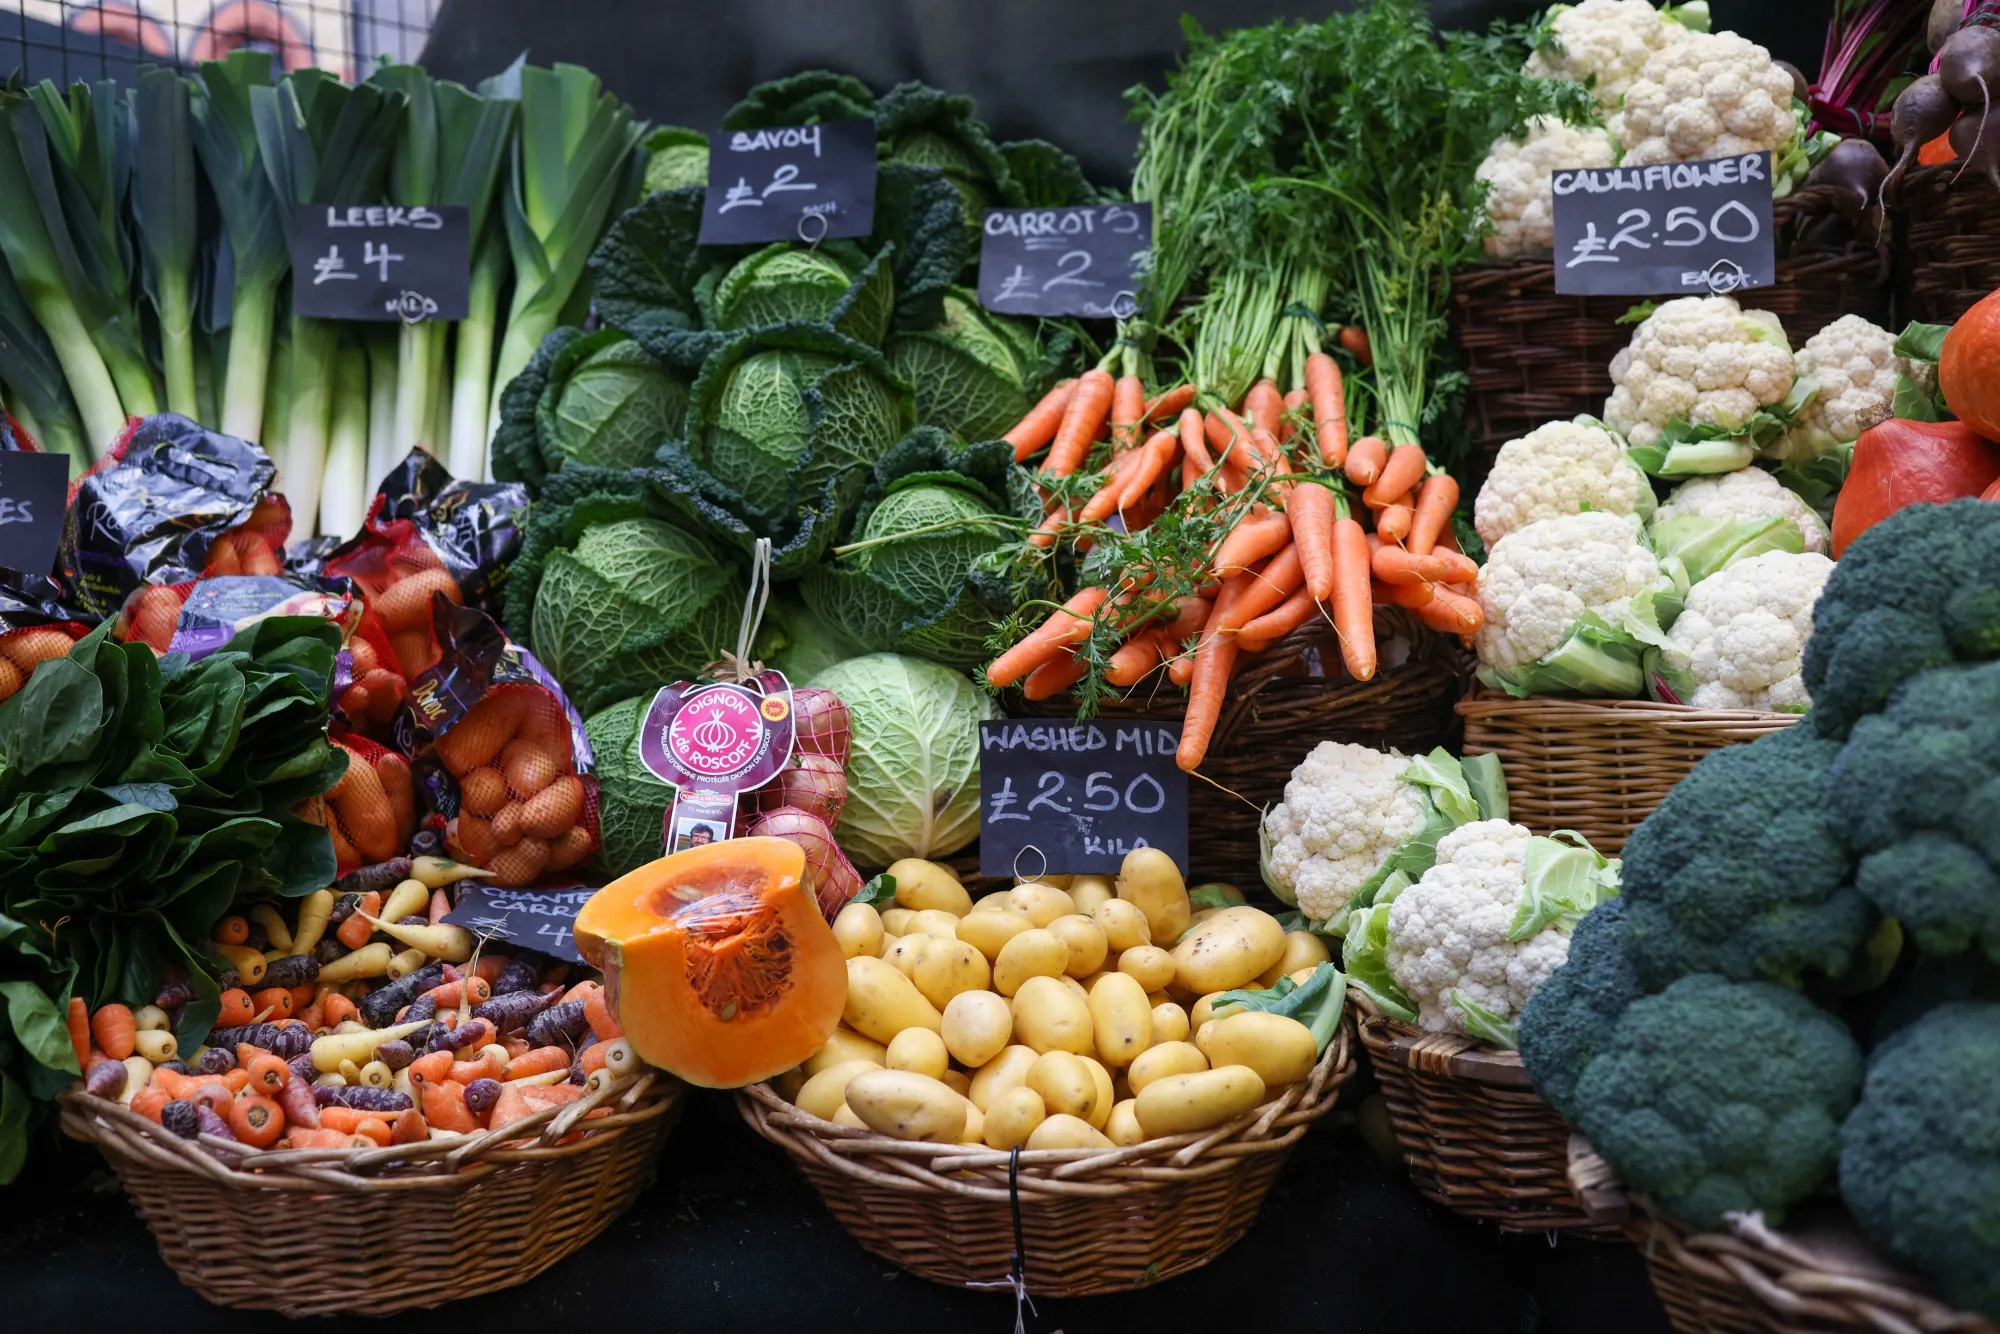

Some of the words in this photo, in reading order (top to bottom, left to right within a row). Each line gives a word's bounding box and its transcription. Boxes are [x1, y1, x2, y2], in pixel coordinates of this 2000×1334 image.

[729, 125, 821, 157] SAVOY
[327, 205, 443, 229] LEEKS
[1566, 200, 1760, 268] £2.50
[688, 693, 748, 715] OIGNON
[676, 737, 690, 754] de
[689, 739, 751, 769] ROSCOFF
[730, 762, 756, 780] OIGNON
[753, 755, 762, 764] DE
[759, 728, 771, 756] ROSCOFF
[981, 724, 1108, 751] WASHED
[1115, 727, 1179, 756] MID
[988, 770, 1165, 824] £2.50
